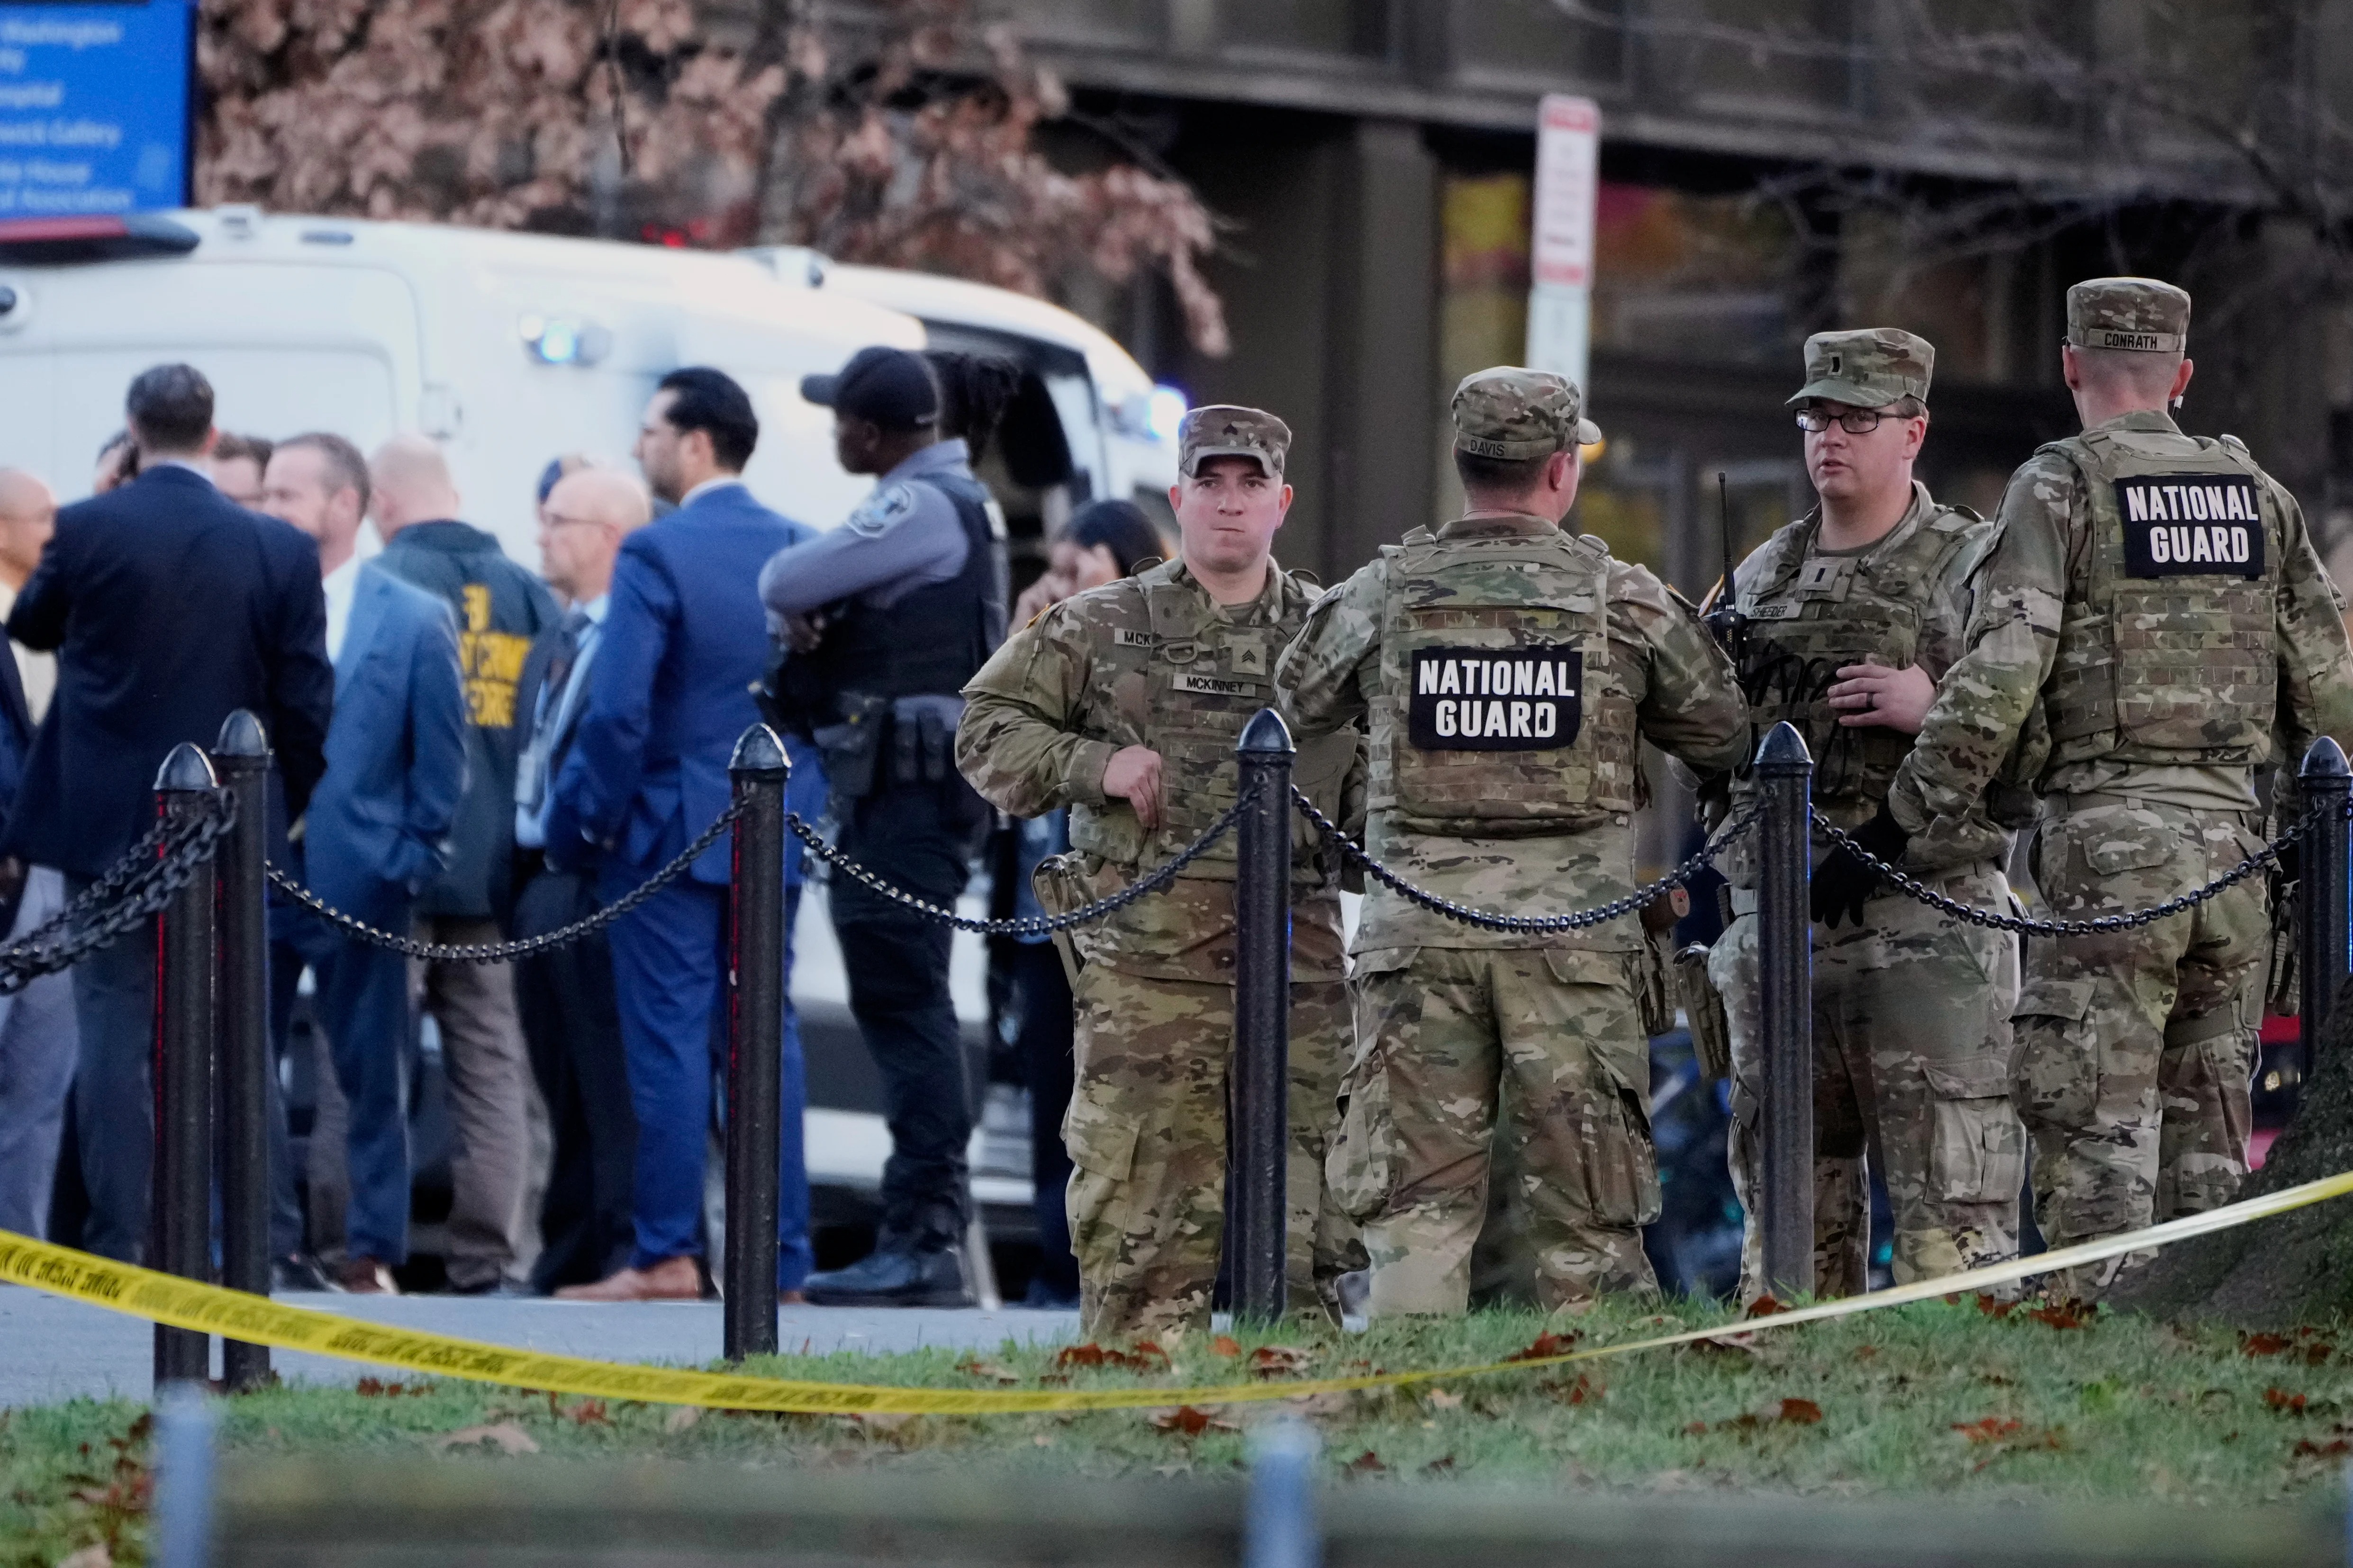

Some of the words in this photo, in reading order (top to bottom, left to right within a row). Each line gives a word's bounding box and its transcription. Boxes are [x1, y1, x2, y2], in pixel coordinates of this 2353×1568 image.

[2104, 333, 2158, 350] CONRATH
[1470, 439, 1505, 457] DAVIS
[2126, 485, 2259, 522] NATIONAL
[2150, 526, 2250, 563] GUARD
[1186, 676, 1244, 693] MCKINNEY
[1419, 659, 1575, 697] NATIONAL
[1436, 699, 1557, 738] GUARD
